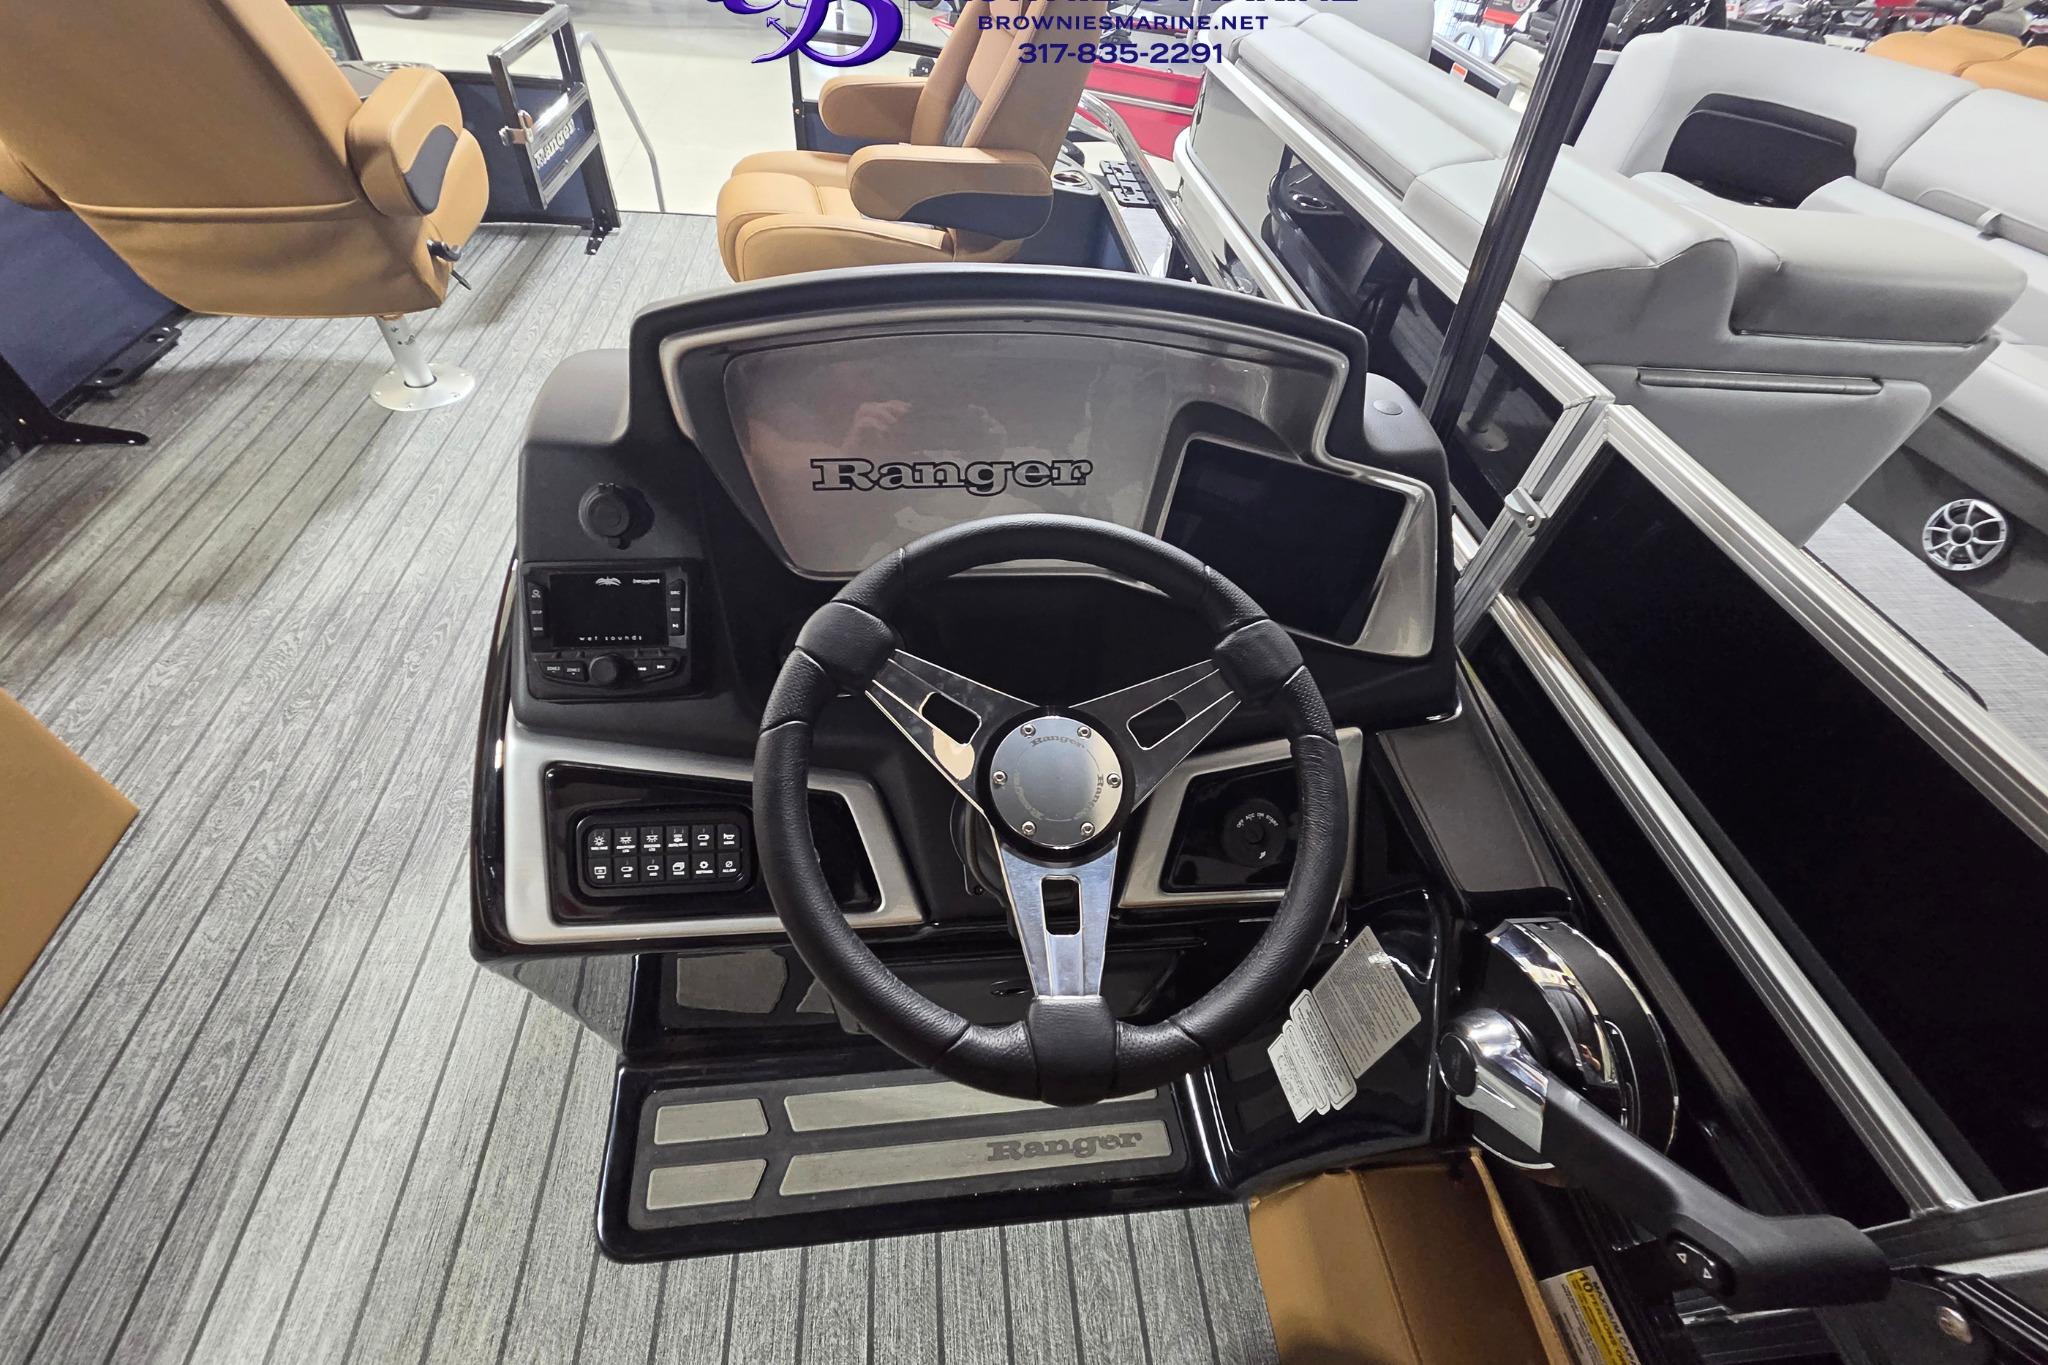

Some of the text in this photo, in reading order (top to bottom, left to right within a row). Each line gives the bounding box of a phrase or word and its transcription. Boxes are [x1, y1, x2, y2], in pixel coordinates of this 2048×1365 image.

[533, 118, 577, 169] Ranger
[810, 458, 1094, 497] Ranger
[986, 1131, 1144, 1162] Ranger
